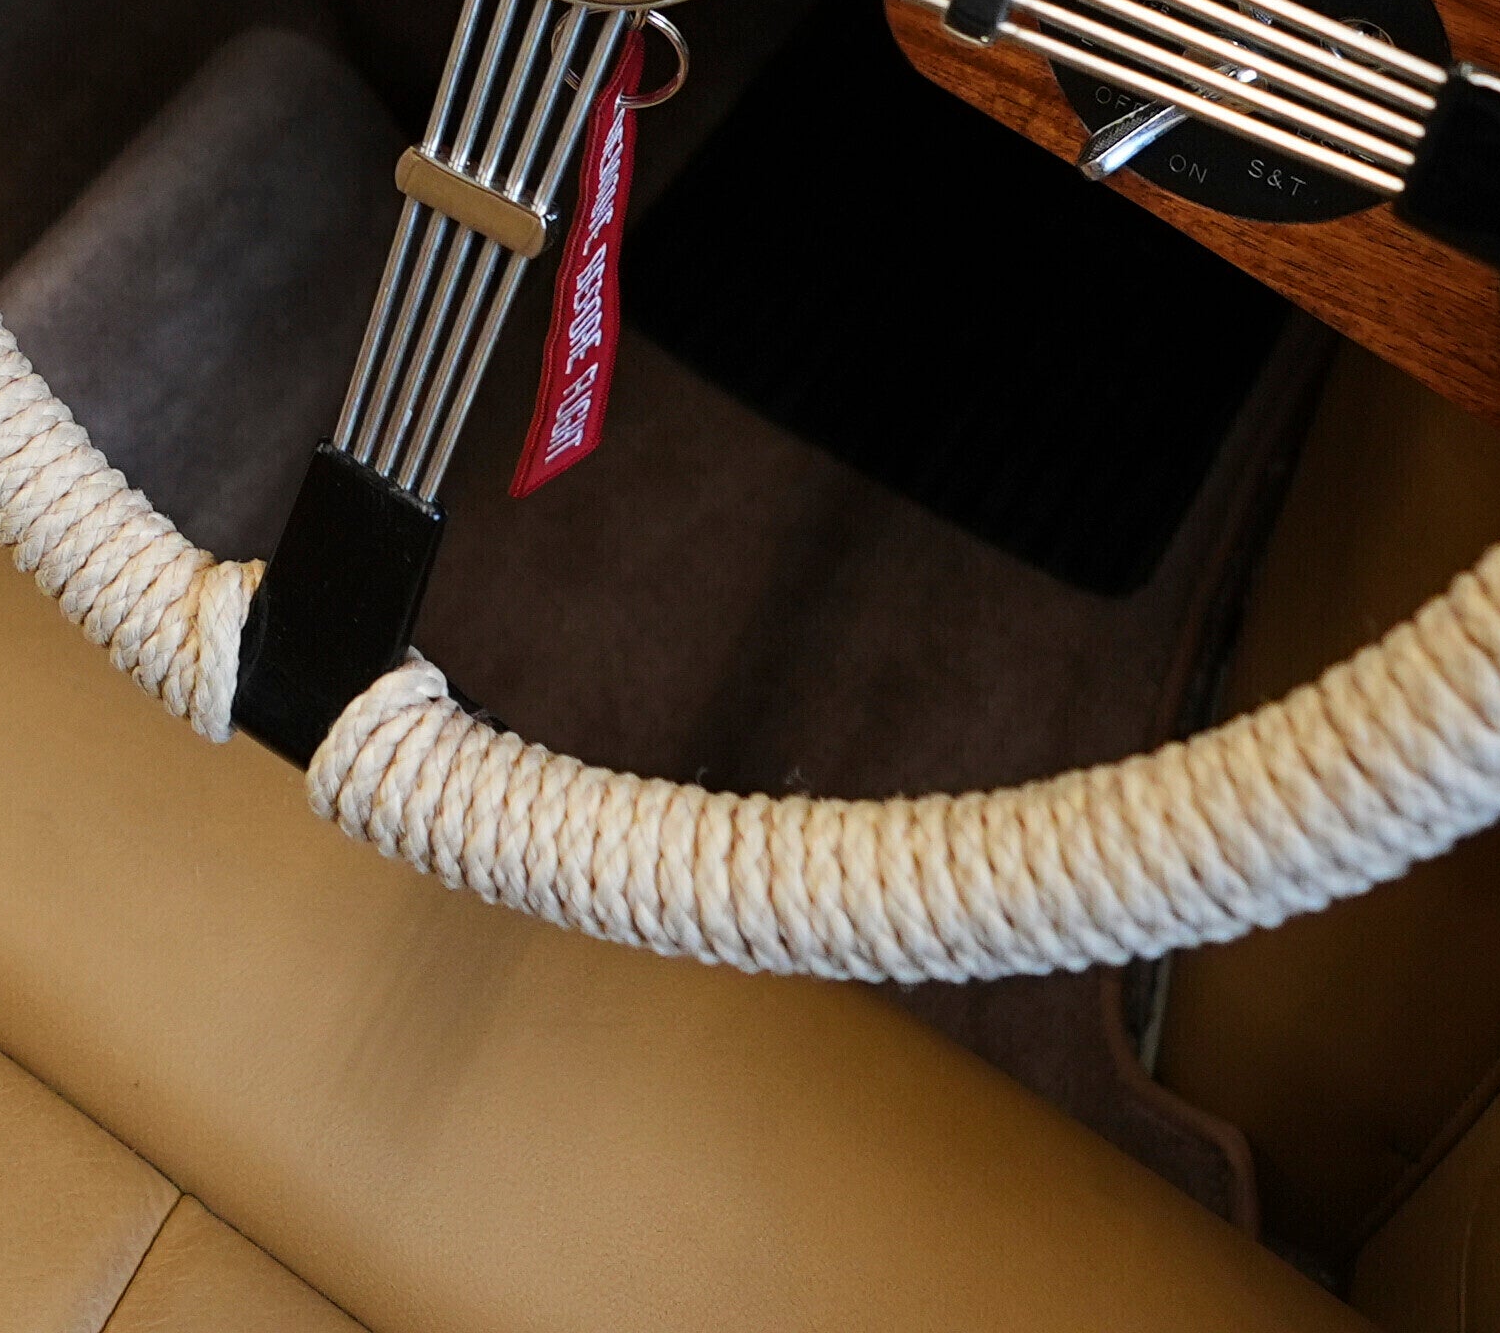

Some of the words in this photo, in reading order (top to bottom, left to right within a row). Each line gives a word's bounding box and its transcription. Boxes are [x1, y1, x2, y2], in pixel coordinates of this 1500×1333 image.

[1169, 153, 1208, 184] ON
[1247, 159, 1307, 197] S&T
[565, 243, 607, 375] BEFORE
[544, 361, 599, 464] FLIGHT
